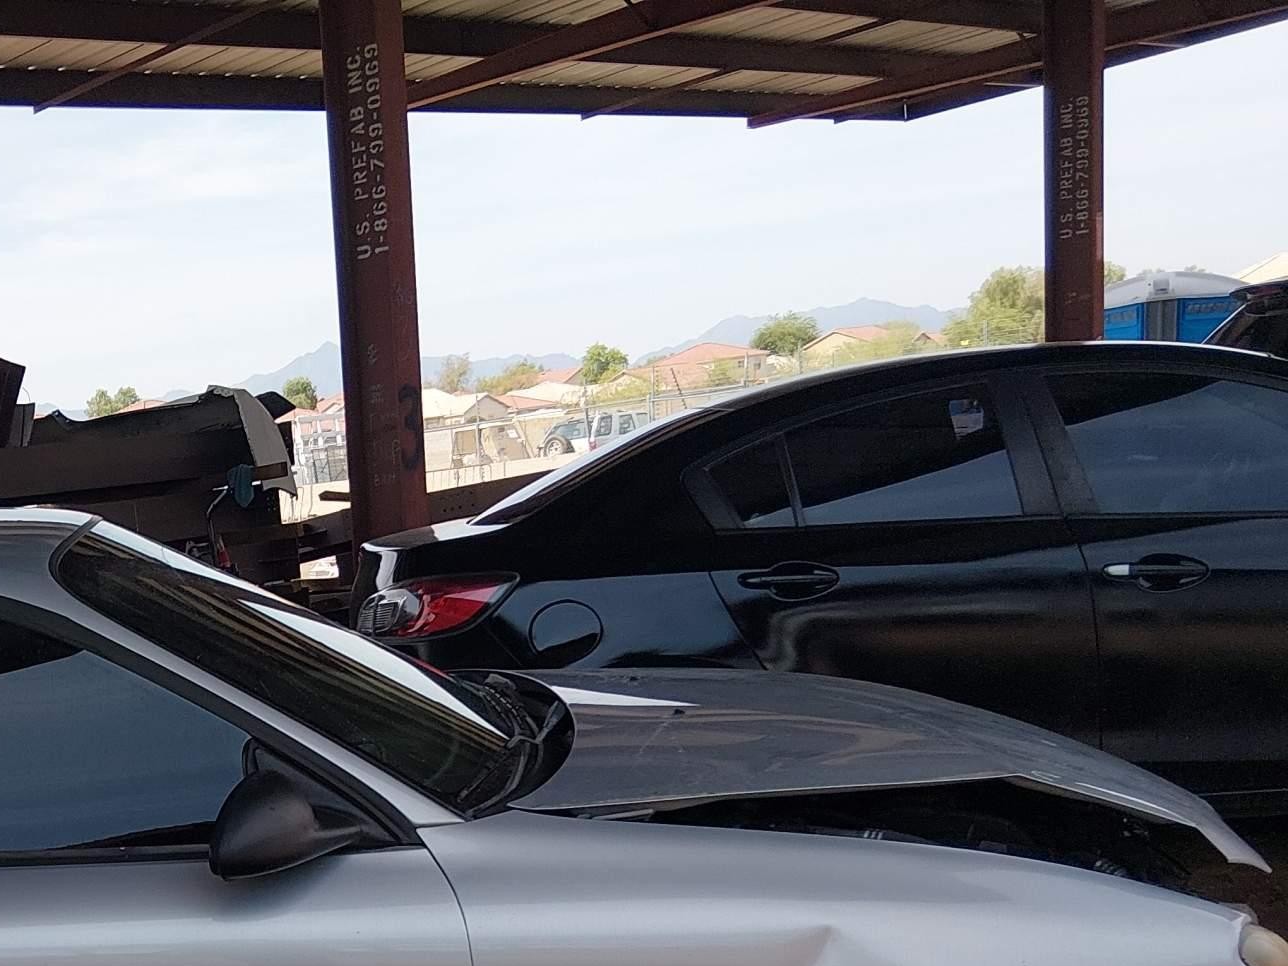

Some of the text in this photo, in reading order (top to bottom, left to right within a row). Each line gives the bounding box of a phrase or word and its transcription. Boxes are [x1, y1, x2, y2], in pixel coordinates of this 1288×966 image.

[346, 46, 372, 260] U.S. PREFAB INC.
[364, 43, 389, 255] 1-866-799-0969
[1059, 96, 1073, 239] U.S. PREFAB INC.
